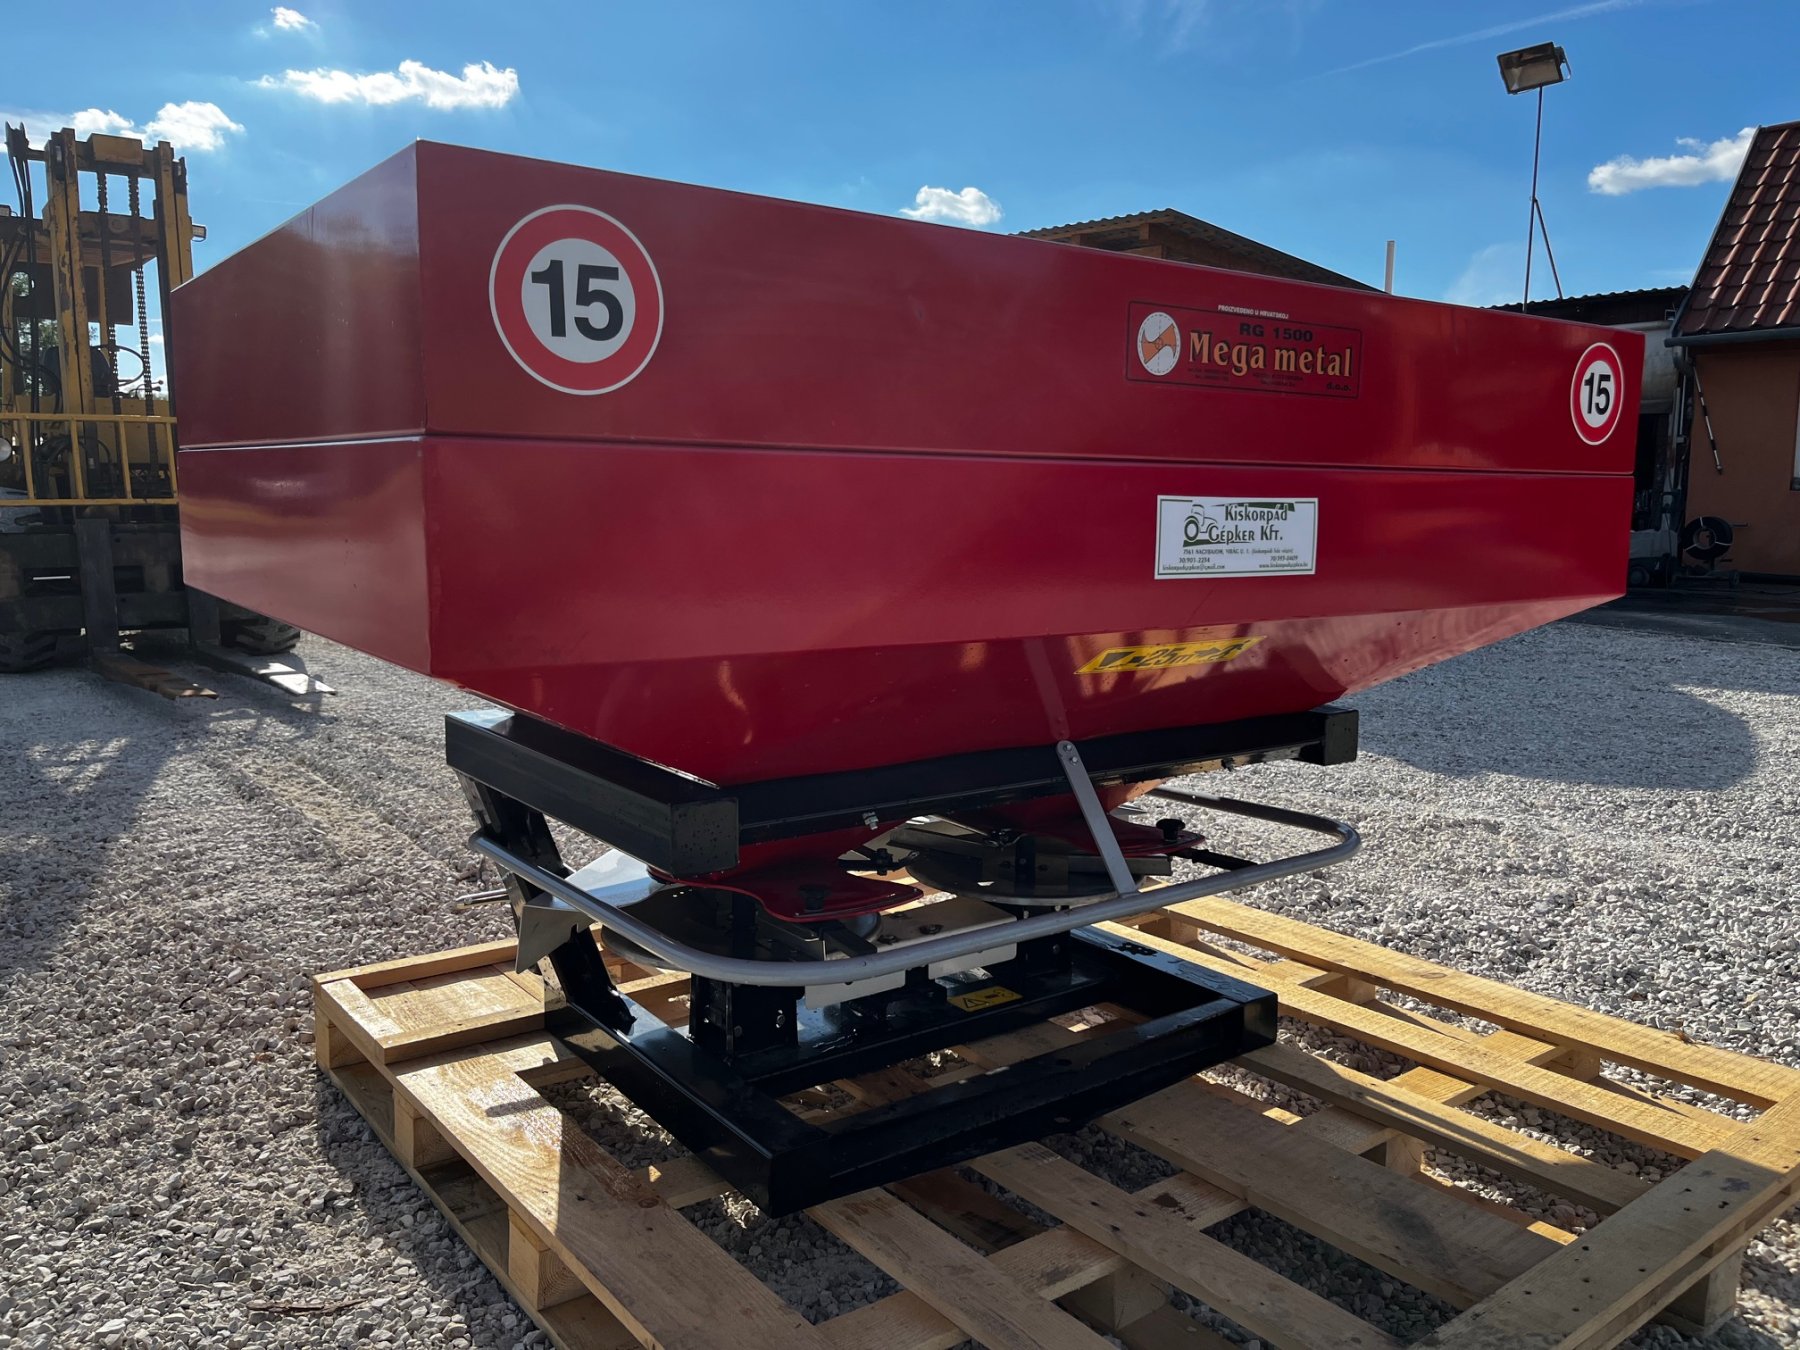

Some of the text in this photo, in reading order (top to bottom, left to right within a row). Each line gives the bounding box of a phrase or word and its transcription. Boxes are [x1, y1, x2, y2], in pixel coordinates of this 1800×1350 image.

[531, 259, 623, 341] 15
[1217, 305, 1254, 315] PROIZVEDENO
[1239, 322, 1313, 343] RG 1500
[1189, 330, 1353, 377] Mega metal
[1584, 372, 1611, 415] 15
[1224, 503, 1288, 524] Kiskorpád
[1208, 524, 1283, 545] Gépker Kft.
